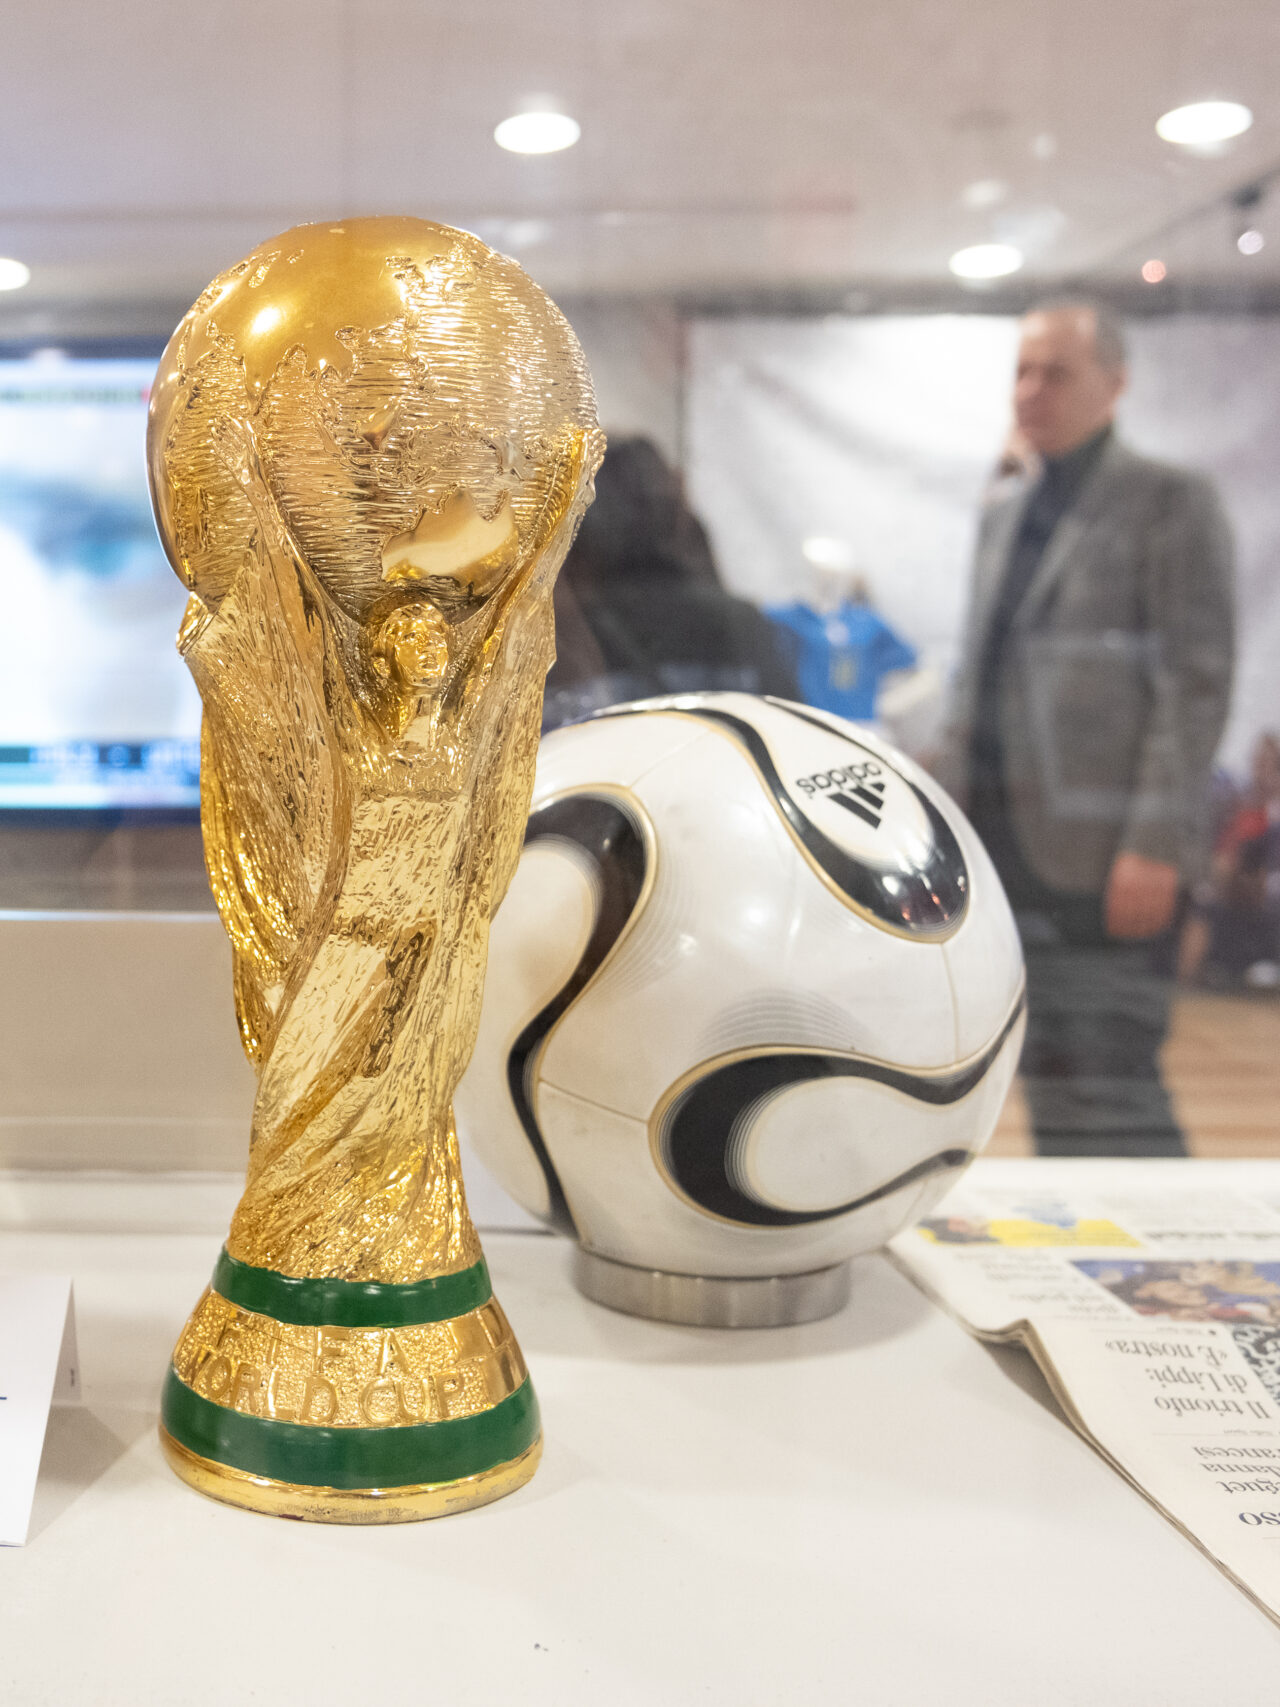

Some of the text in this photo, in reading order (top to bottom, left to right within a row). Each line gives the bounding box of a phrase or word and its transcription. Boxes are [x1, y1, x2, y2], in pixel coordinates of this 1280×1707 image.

[796, 761, 882, 794] adidas
[1145, 1365, 1248, 1394] di Lippi:
[360, 1370, 465, 1425] CUP
[1154, 1396, 1244, 1417] trionfo
[1215, 1478, 1280, 1494] guet
